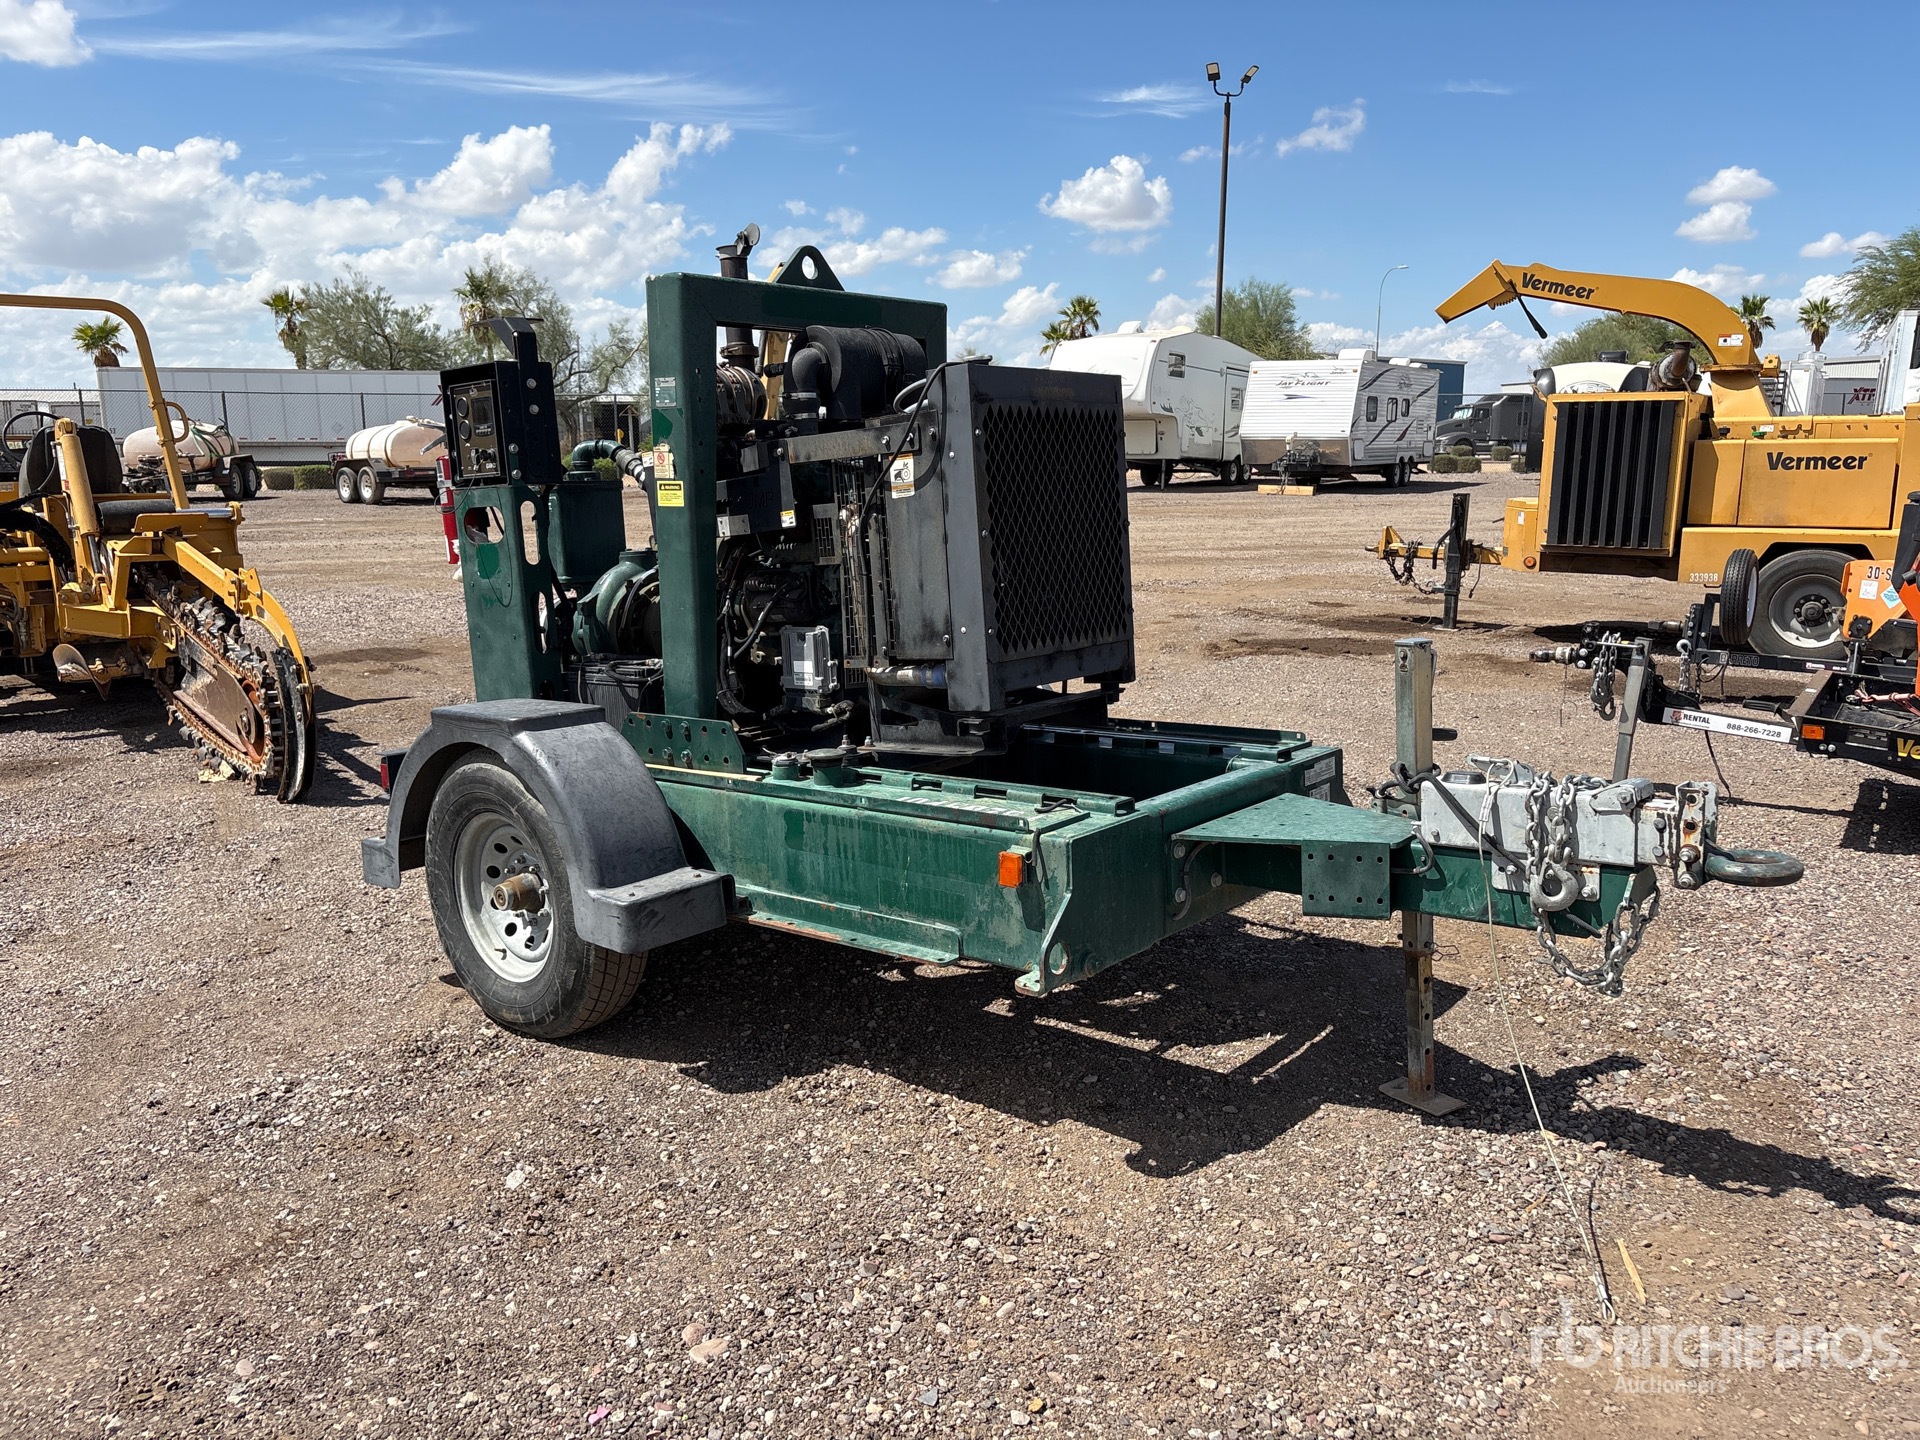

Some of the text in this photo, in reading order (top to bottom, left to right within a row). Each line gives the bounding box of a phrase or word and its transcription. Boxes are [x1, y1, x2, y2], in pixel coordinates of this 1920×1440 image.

[1522, 272, 1595, 299] Vermeer
[1766, 451, 1868, 471] Vermeer
[1689, 572, 1719, 582] 333938
[1683, 713, 1711, 725] RENTAL
[1726, 722, 1782, 738] 888-266-7228
